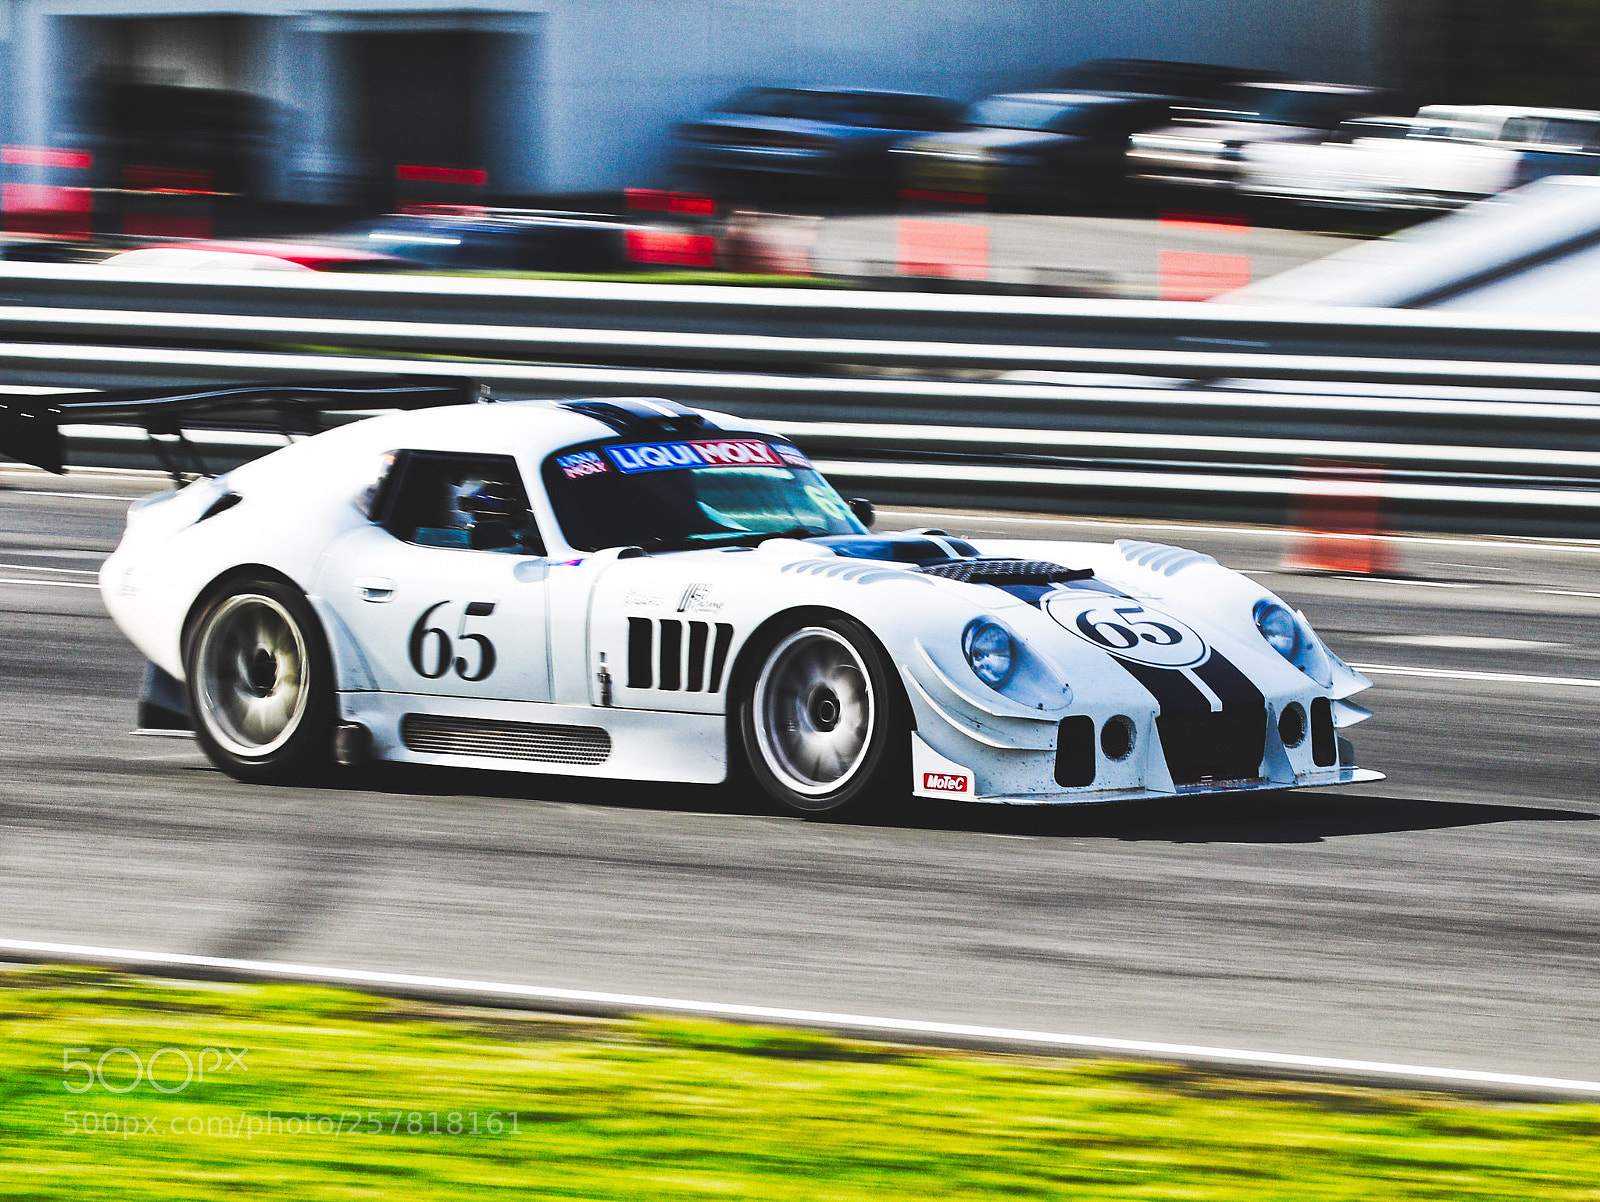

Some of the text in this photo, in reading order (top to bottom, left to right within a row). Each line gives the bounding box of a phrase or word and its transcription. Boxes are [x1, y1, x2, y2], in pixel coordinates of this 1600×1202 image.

[609, 443, 704, 469] LIQUI
[691, 441, 776, 464] MOLY
[409, 600, 497, 682] 65
[1076, 606, 1183, 650] 65
[926, 774, 965, 791] MoTeC
